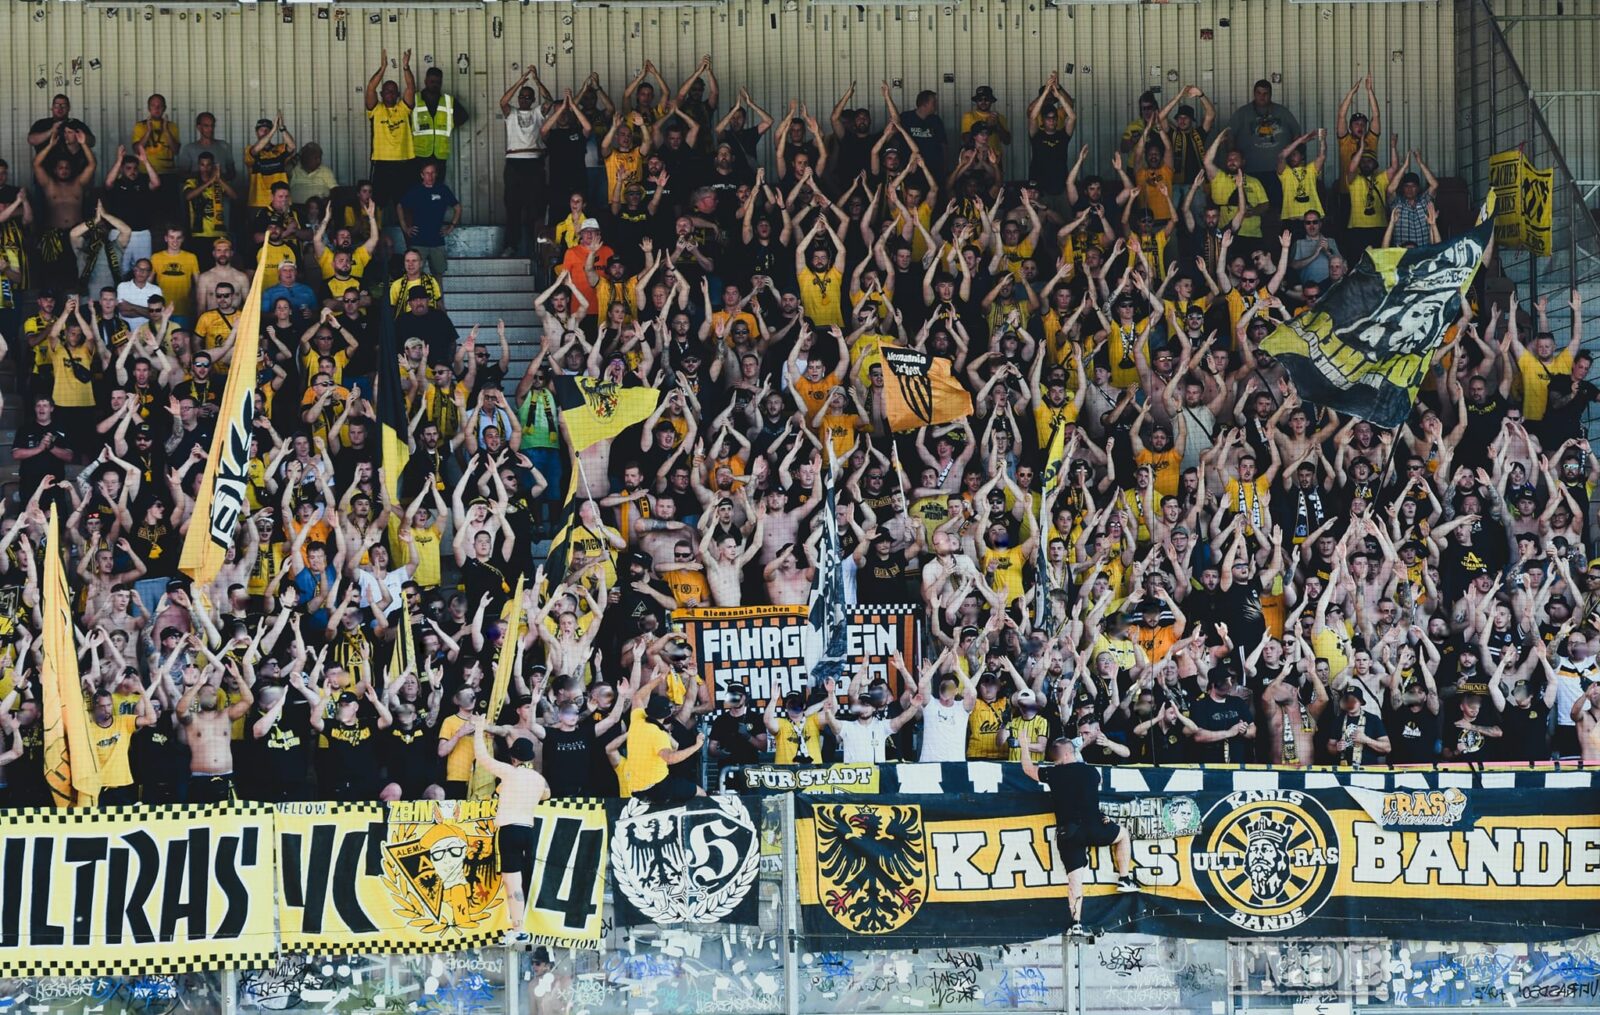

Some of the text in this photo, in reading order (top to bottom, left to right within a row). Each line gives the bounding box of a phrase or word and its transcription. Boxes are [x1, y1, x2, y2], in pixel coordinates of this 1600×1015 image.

[756, 607, 790, 615] Aachen
[747, 767, 795, 788] FÜR
[800, 767, 871, 786] STADT
[276, 803, 326, 814] YELLOW
[1230, 908, 1306, 930] BANDE
